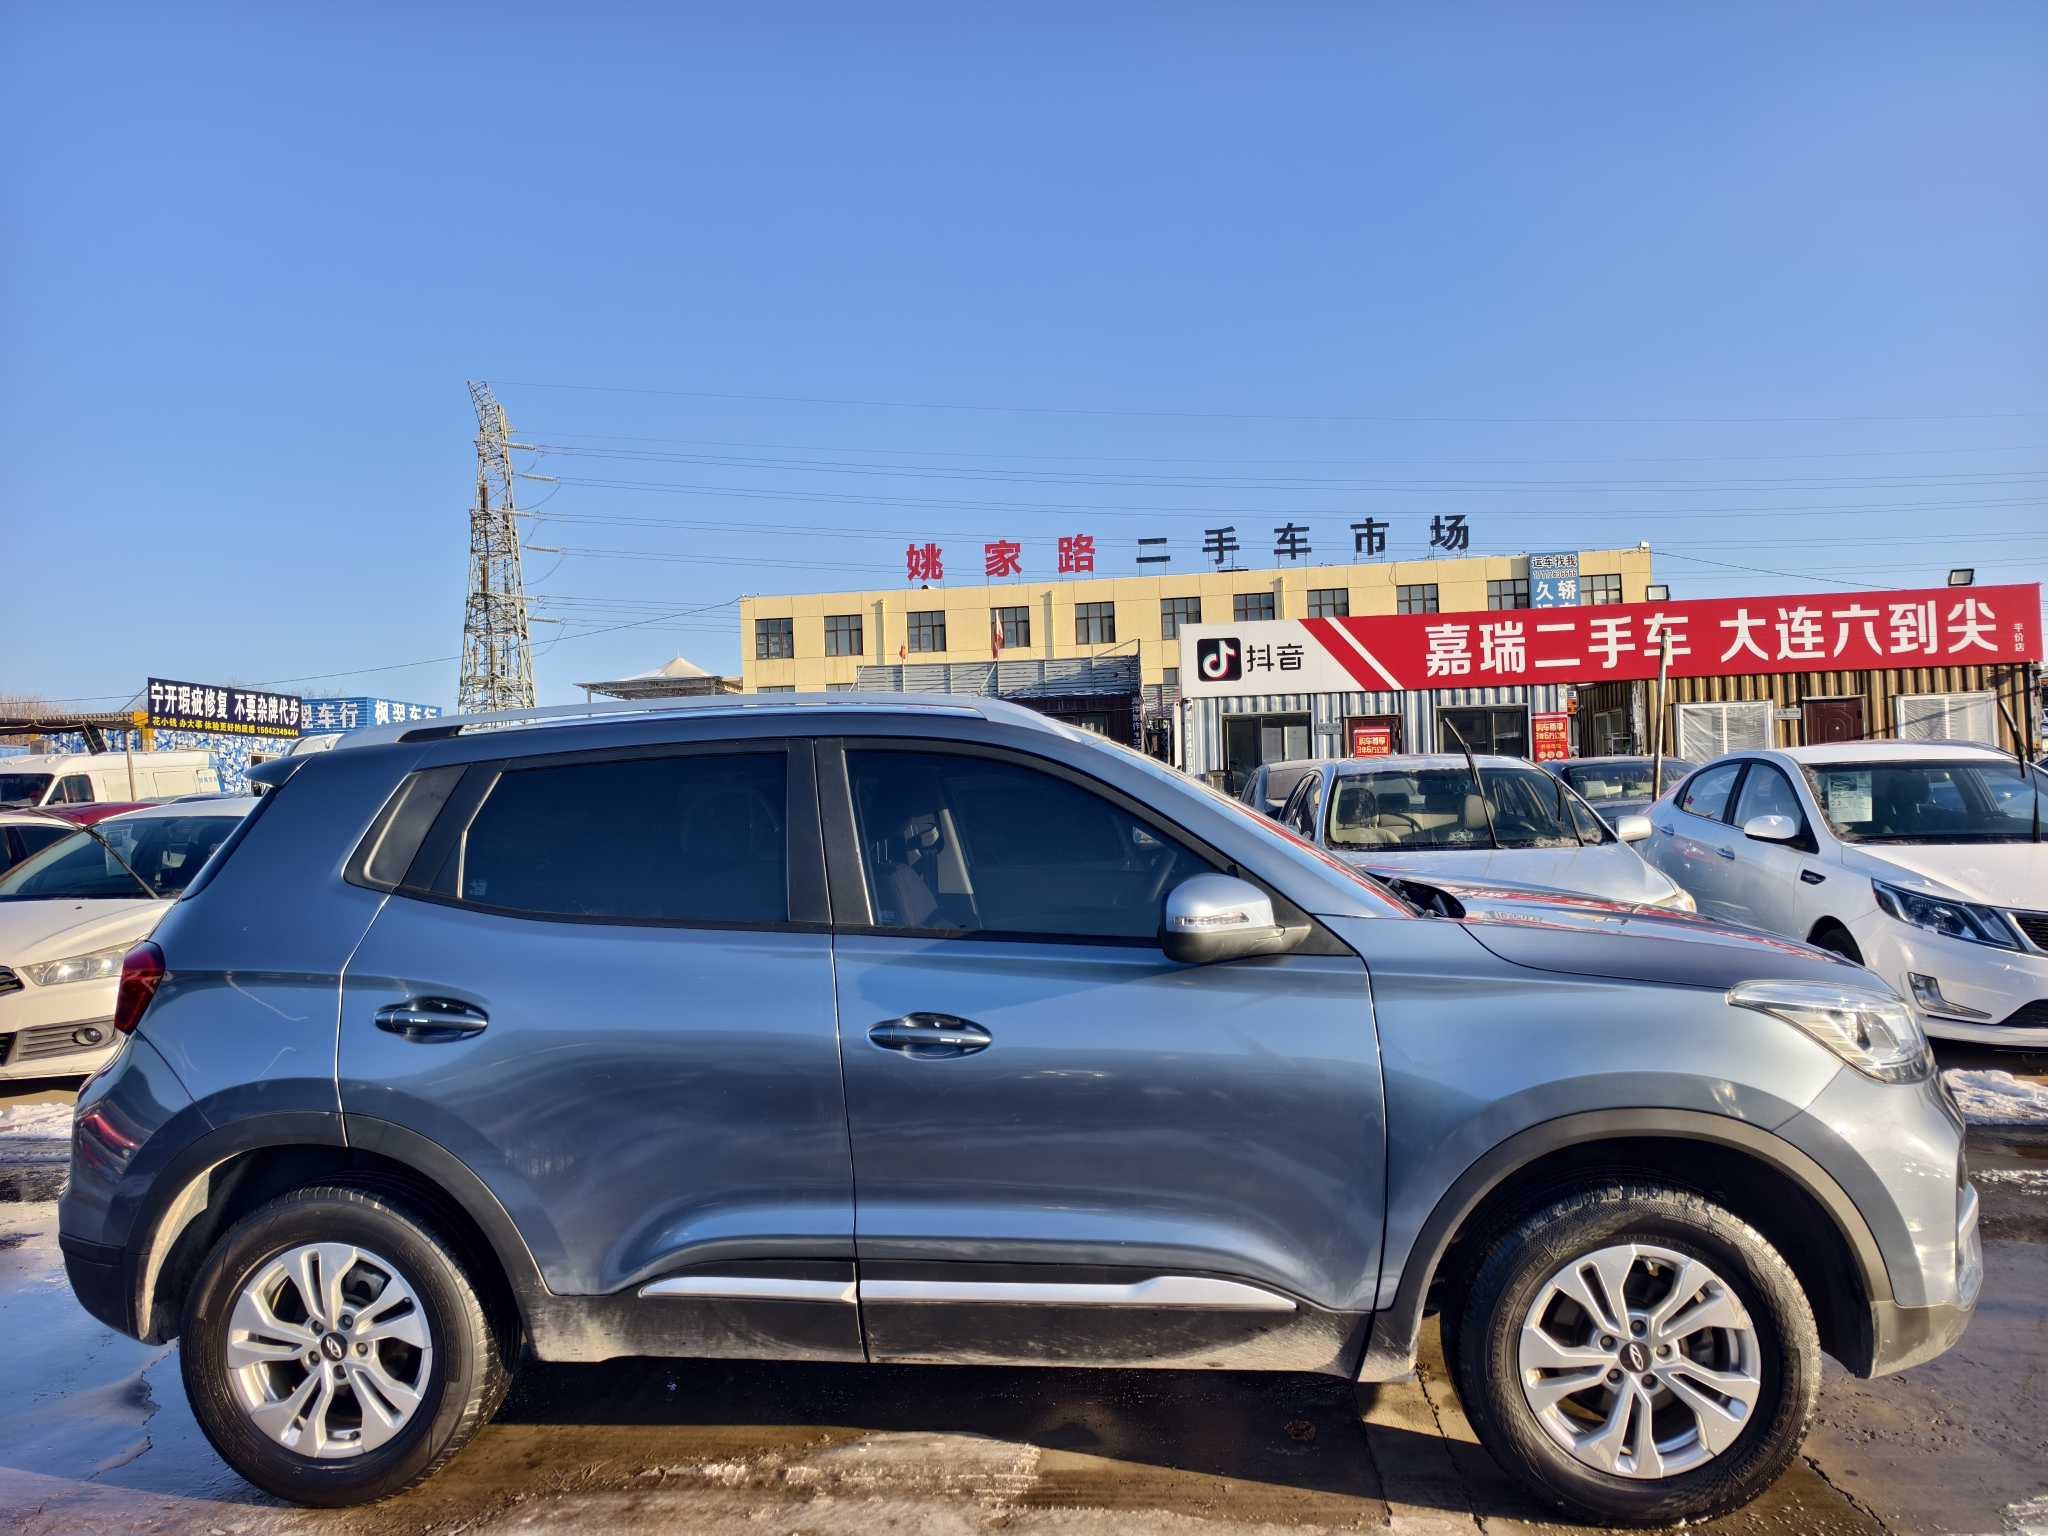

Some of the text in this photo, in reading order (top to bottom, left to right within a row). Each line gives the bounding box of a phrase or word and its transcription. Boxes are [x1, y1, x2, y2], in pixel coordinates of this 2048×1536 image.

[906, 514, 1470, 581] 姚家路二手车市场
[1532, 554, 1577, 569] 运车找我
[1425, 598, 1998, 677] 嘉瑞二手车 大连六到尖
[2013, 623, 2025, 652] 平价店
[1247, 643, 1304, 673] 抖音
[151, 682, 300, 726] 宁开瑕疵修复 不要杂牌代步
[152, 716, 177, 728] 花小钱
[179, 719, 203, 731] 办大事
